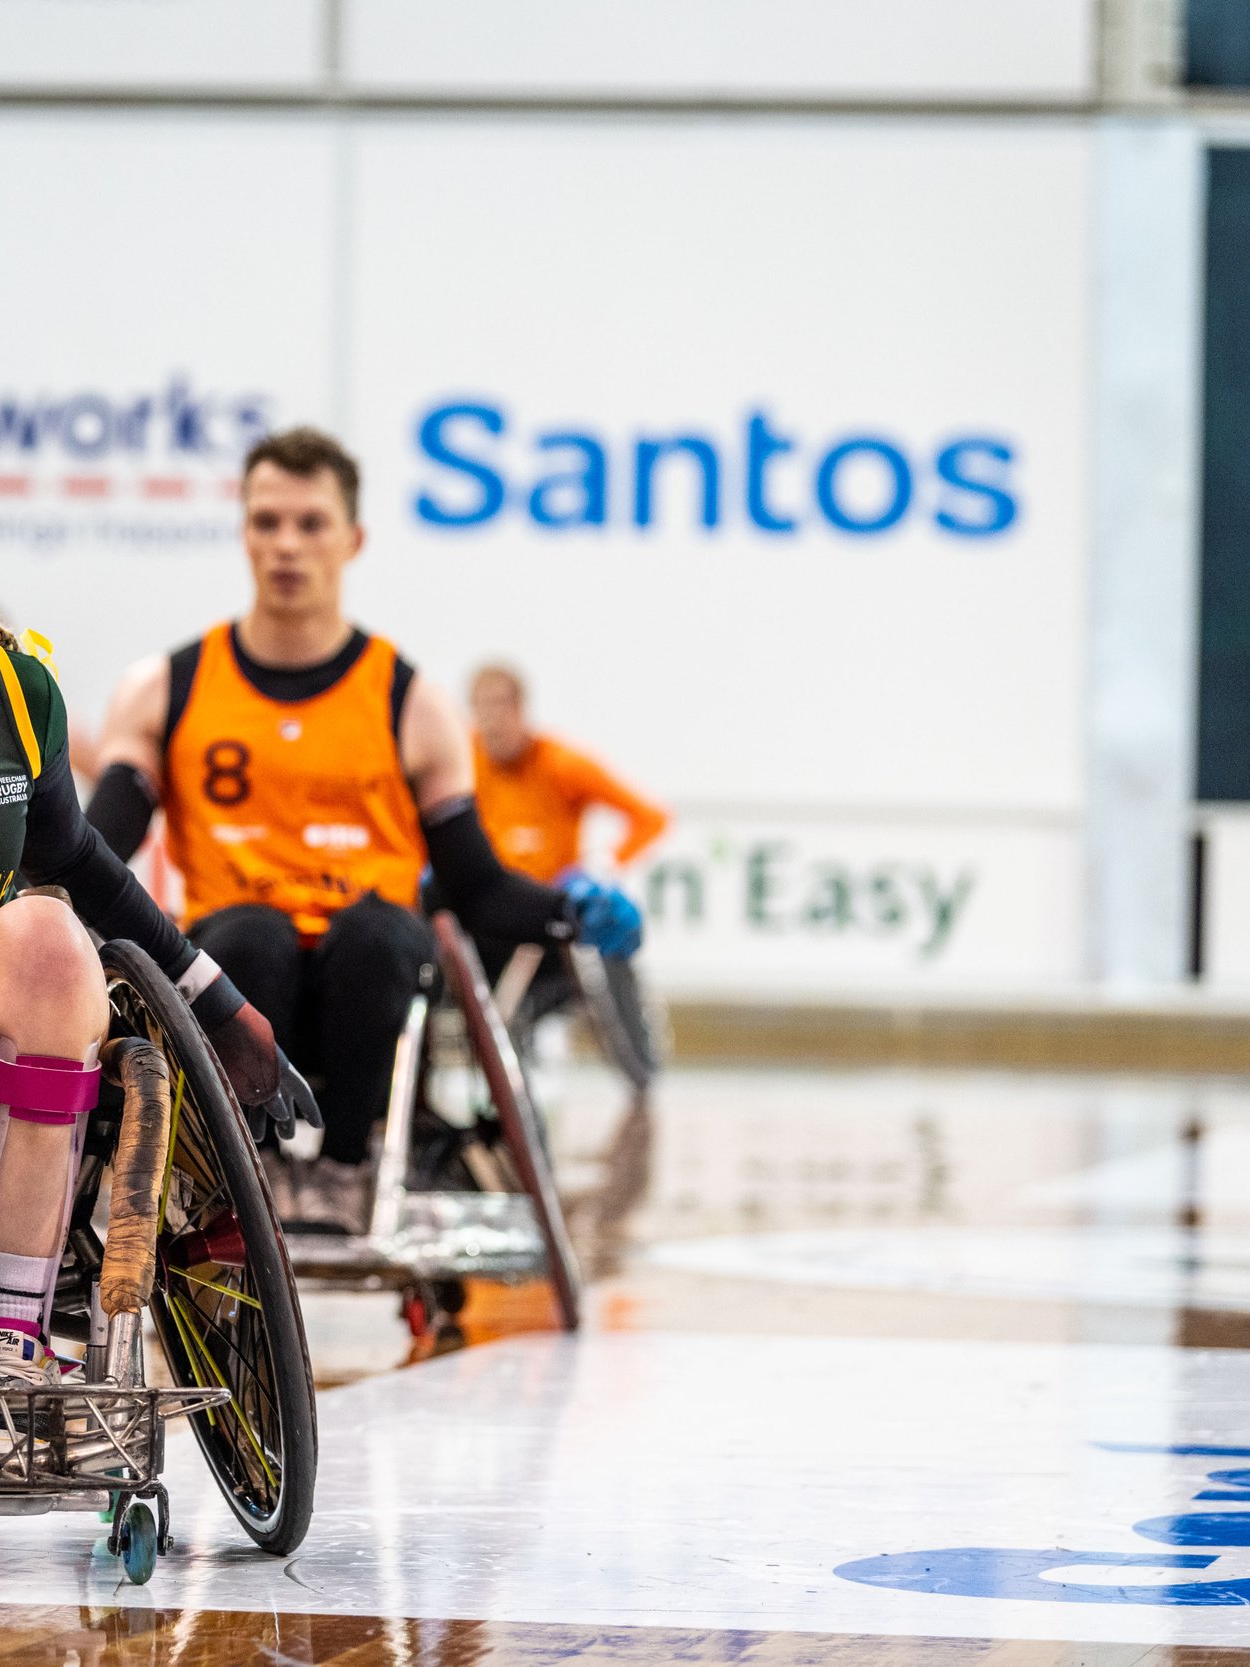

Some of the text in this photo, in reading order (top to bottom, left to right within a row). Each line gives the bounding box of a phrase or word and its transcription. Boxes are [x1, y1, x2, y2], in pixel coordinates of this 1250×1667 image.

[415, 400, 1018, 536] Santos
[204, 739, 250, 807] 8
[748, 840, 976, 963] Easy
